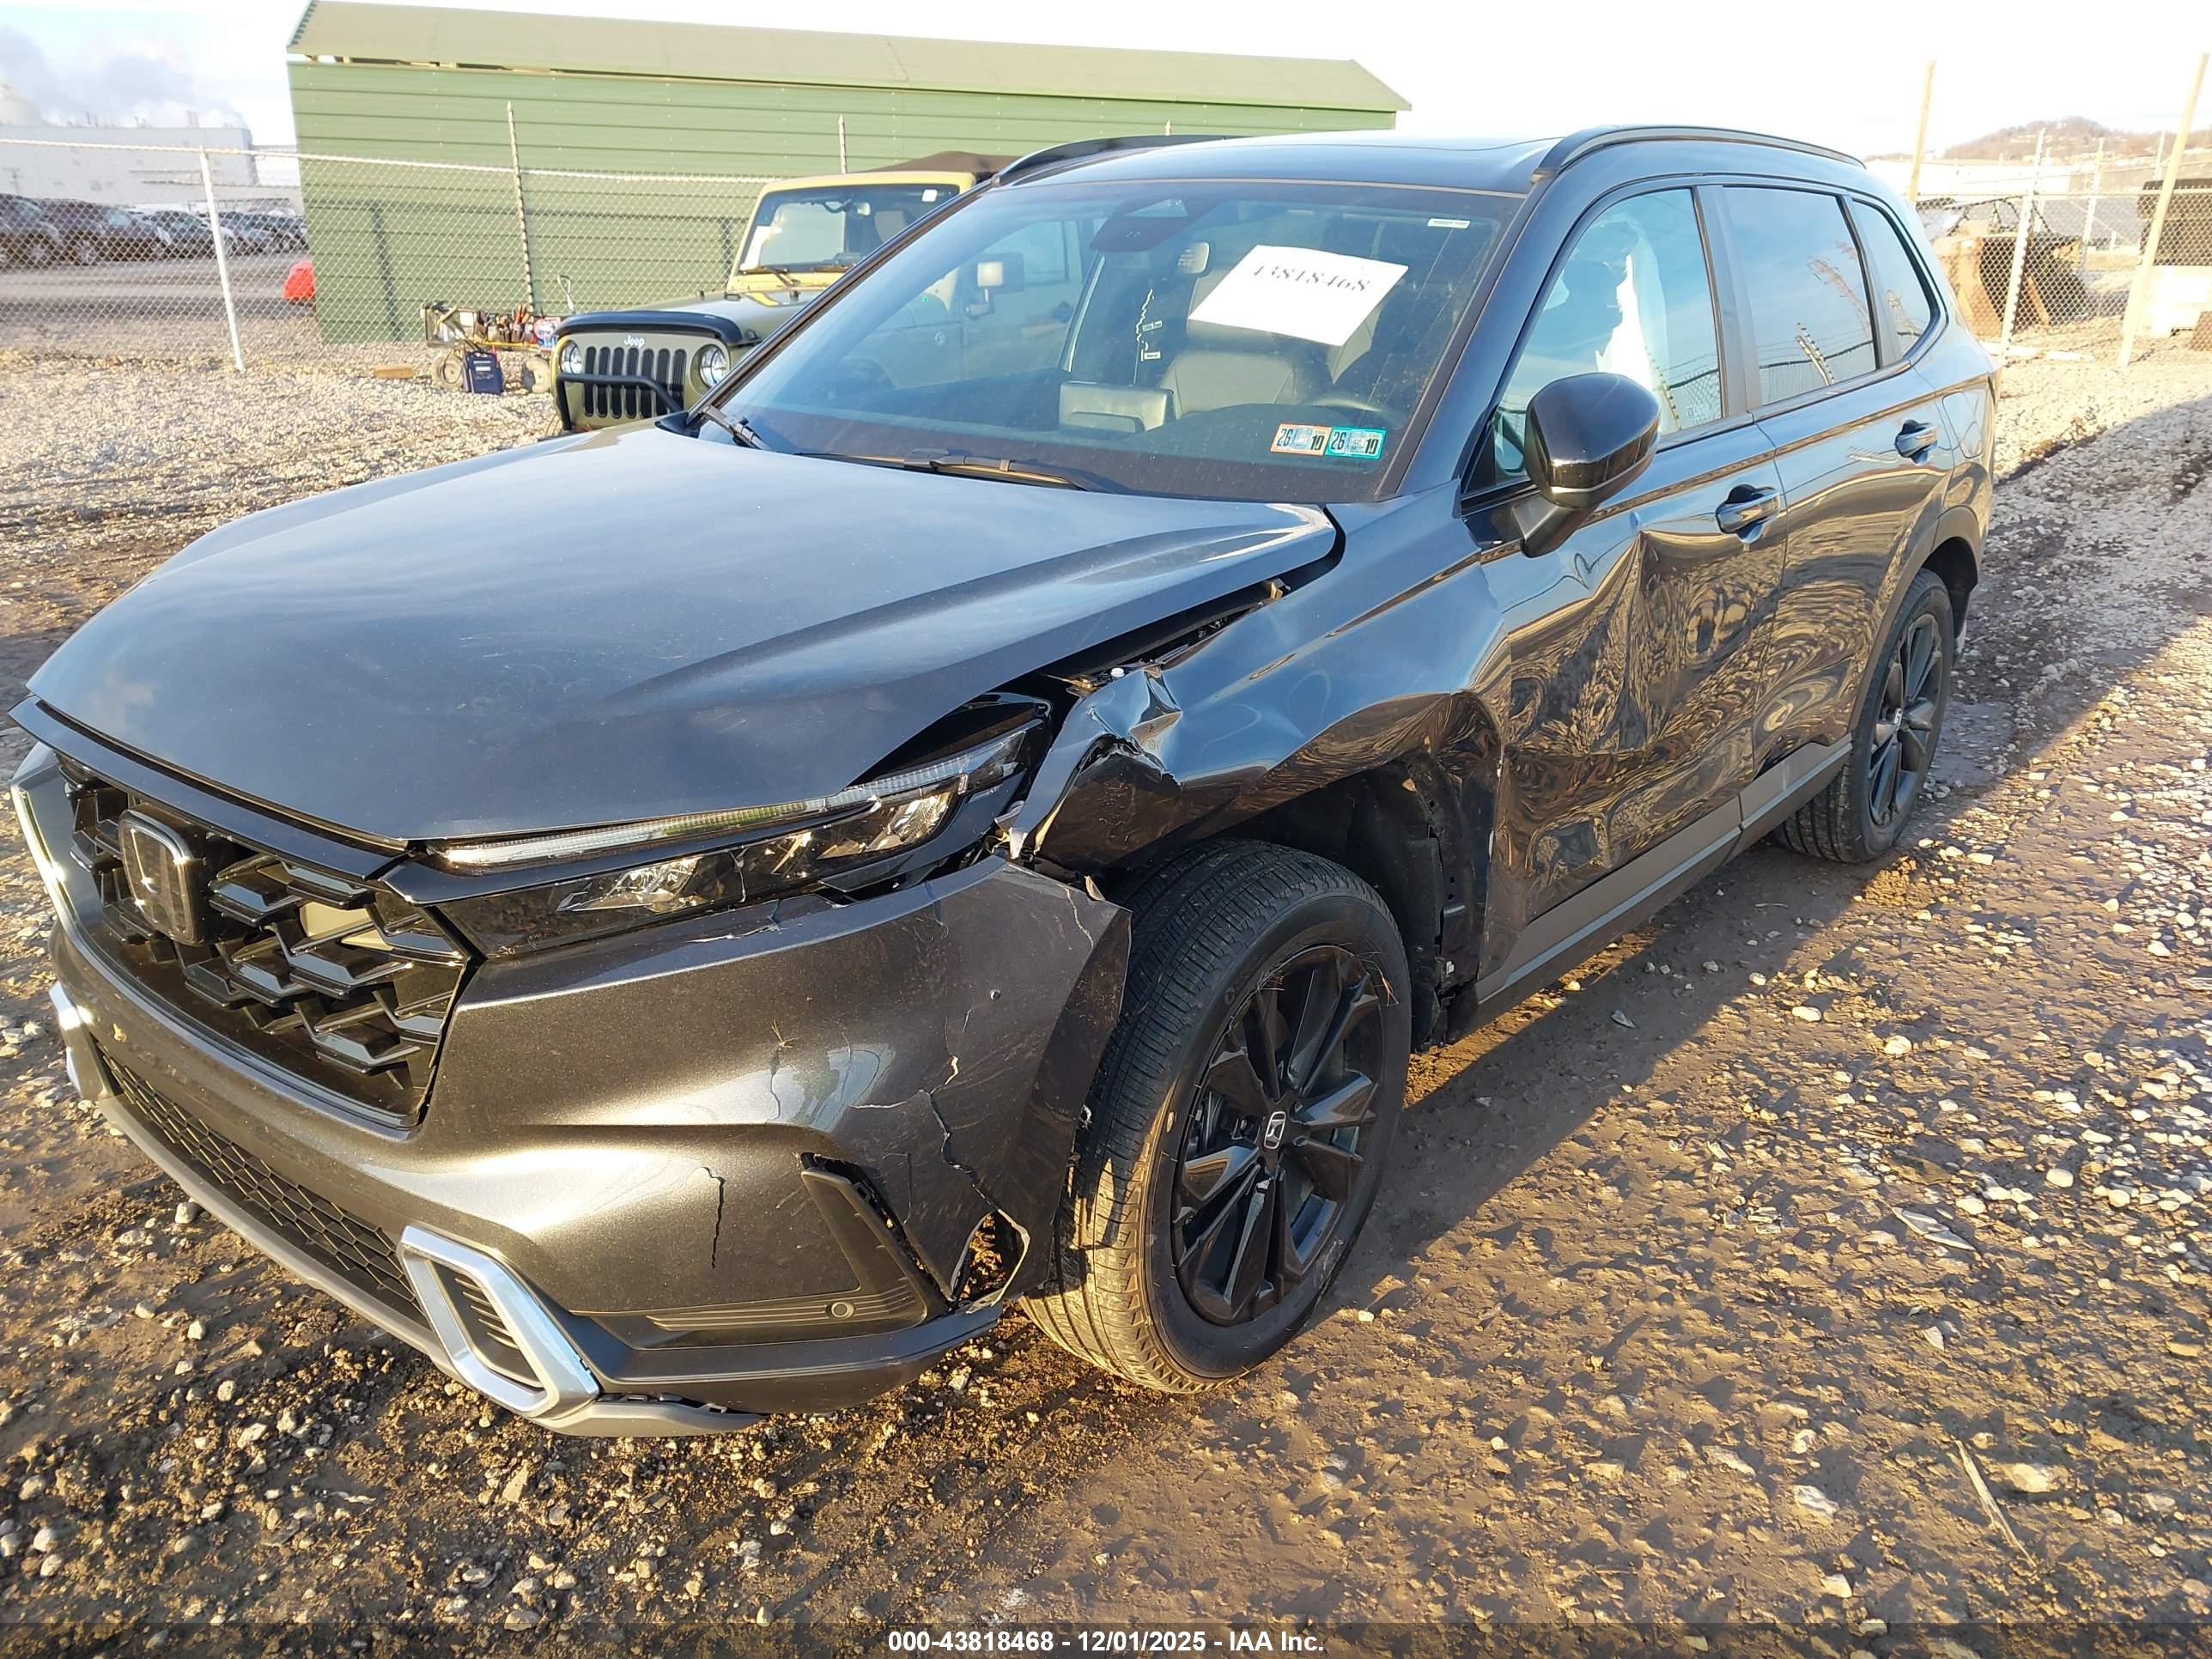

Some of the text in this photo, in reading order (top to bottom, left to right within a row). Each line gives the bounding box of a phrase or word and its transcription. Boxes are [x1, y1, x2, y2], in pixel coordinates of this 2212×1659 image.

[624, 334, 645, 348] Jeep
[1276, 428, 1326, 451] 26 10
[1330, 432, 1379, 454] 26 10
